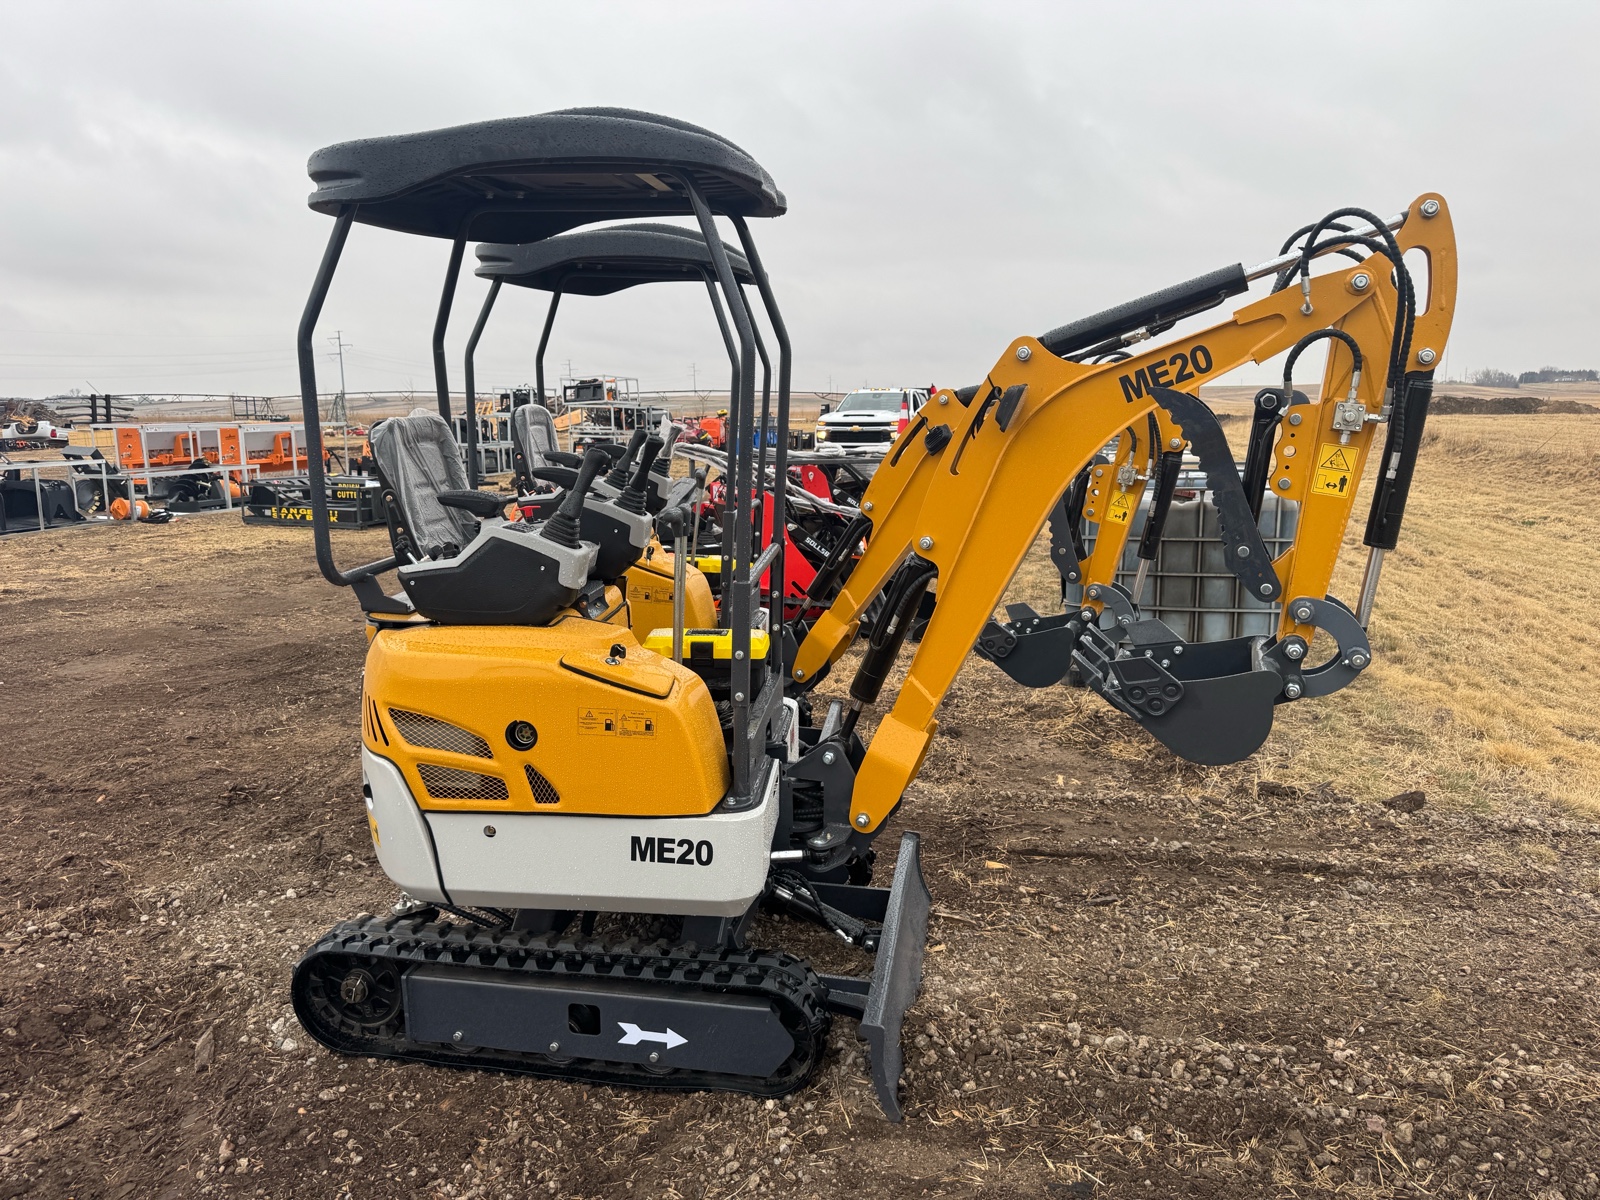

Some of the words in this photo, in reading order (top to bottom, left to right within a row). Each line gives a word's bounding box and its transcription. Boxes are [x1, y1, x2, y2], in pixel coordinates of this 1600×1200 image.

[1118, 345, 1213, 403] ME20
[305, 515, 339, 523] BK
[630, 835, 714, 866] ME20
